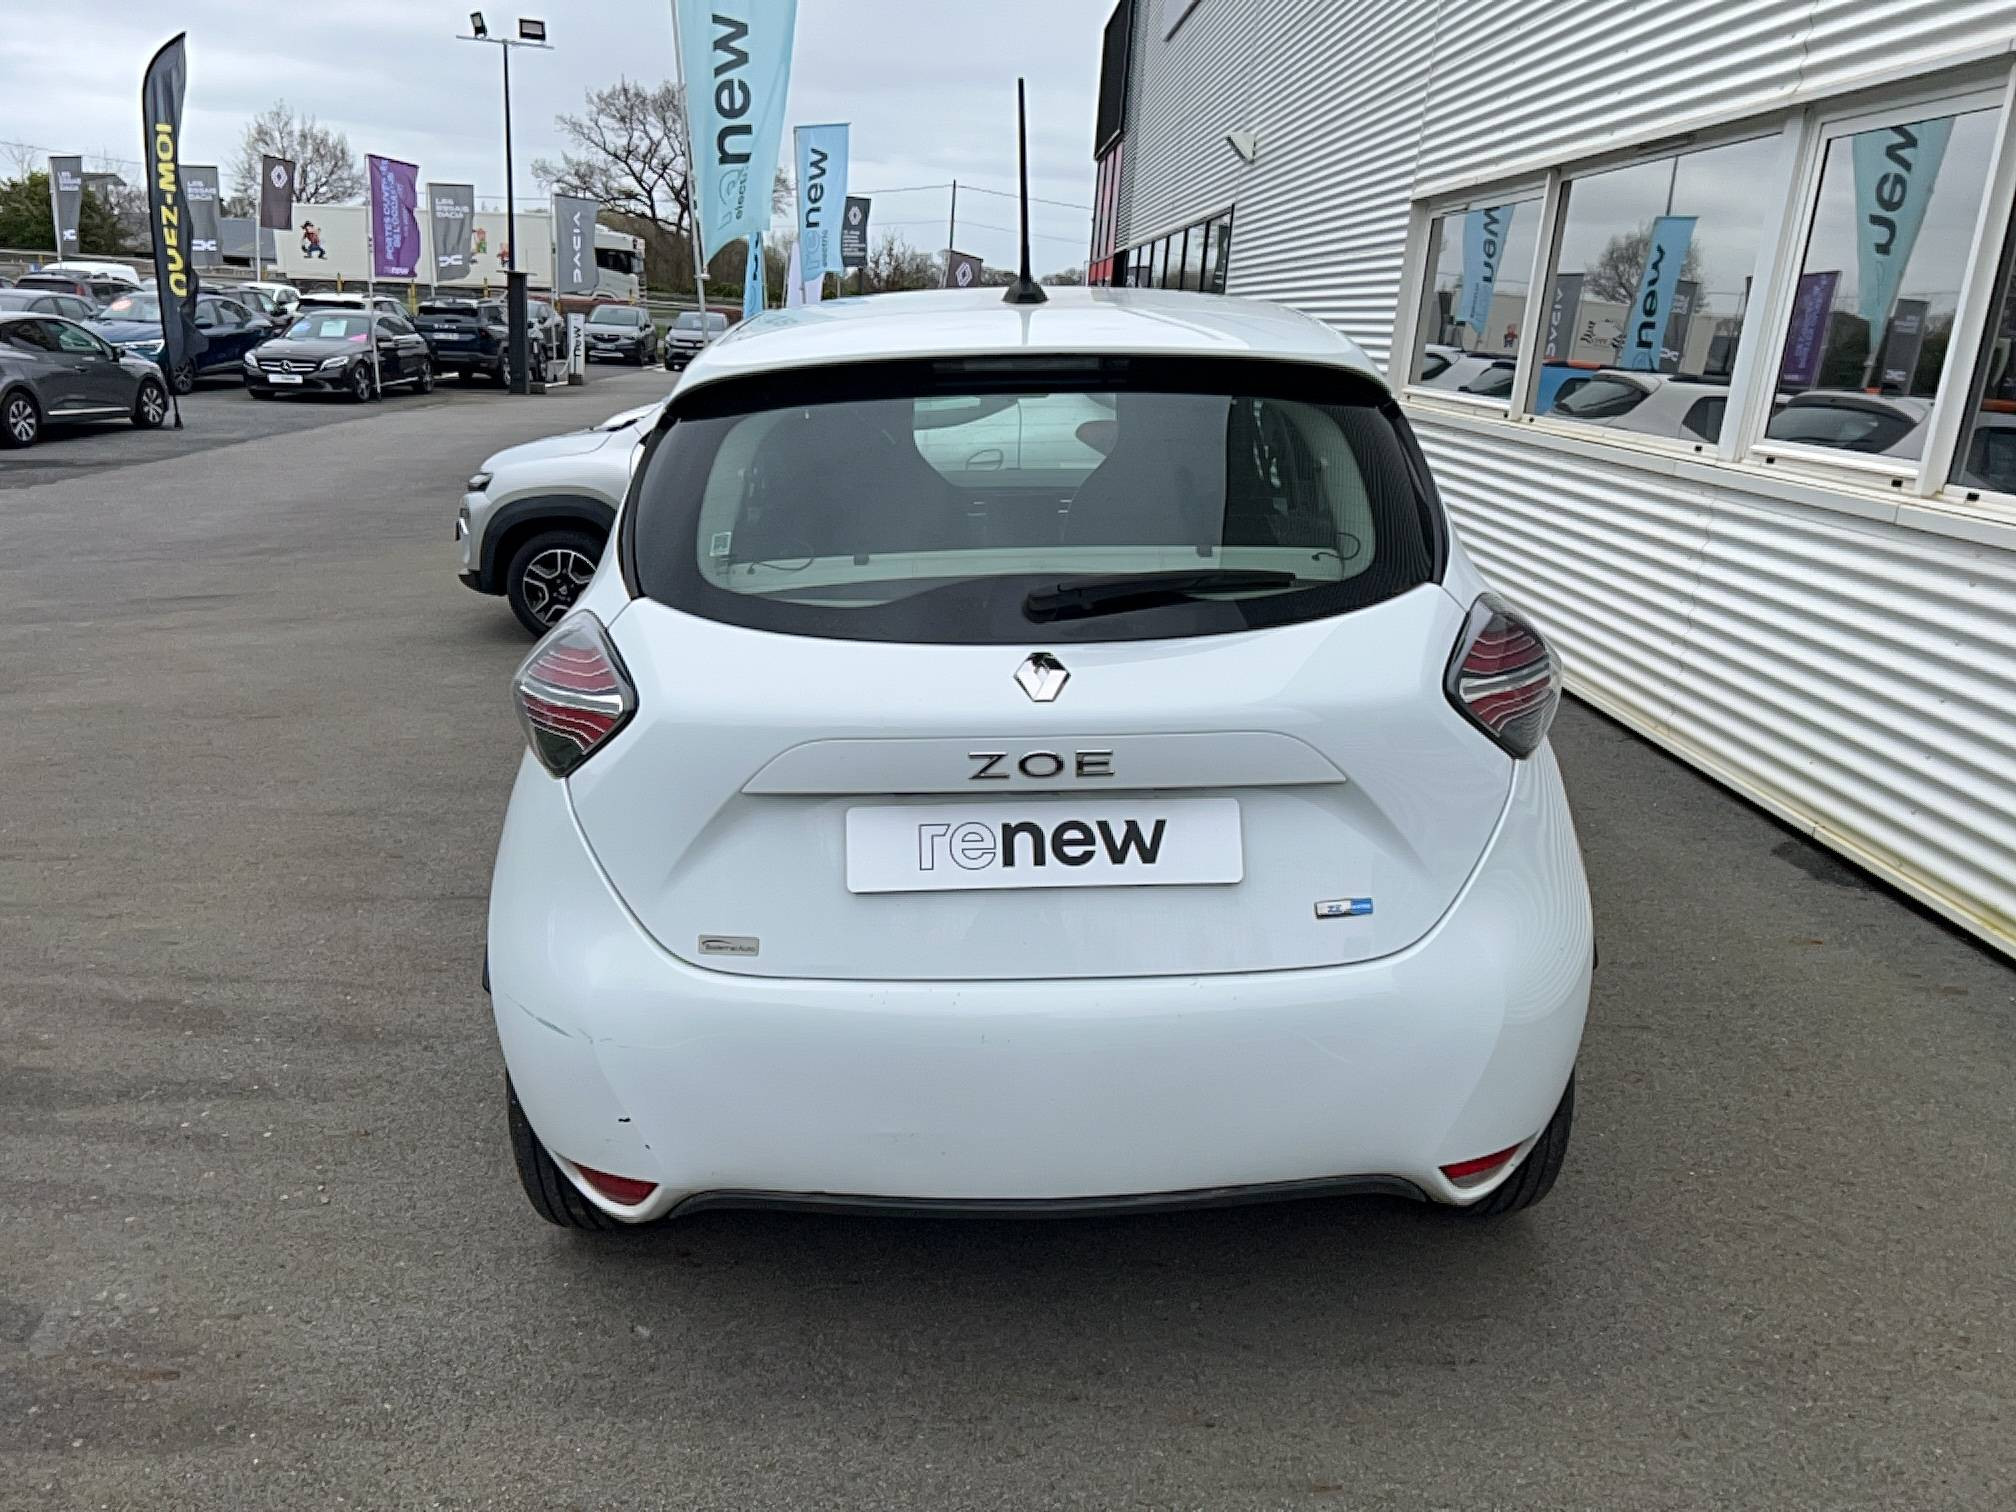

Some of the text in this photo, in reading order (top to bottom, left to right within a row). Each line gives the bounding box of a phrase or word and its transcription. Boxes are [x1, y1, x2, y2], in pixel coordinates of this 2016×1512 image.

[573, 211, 582, 284] DACIA
[968, 749, 1115, 779] ZOE
[918, 818, 1168, 871] renew
